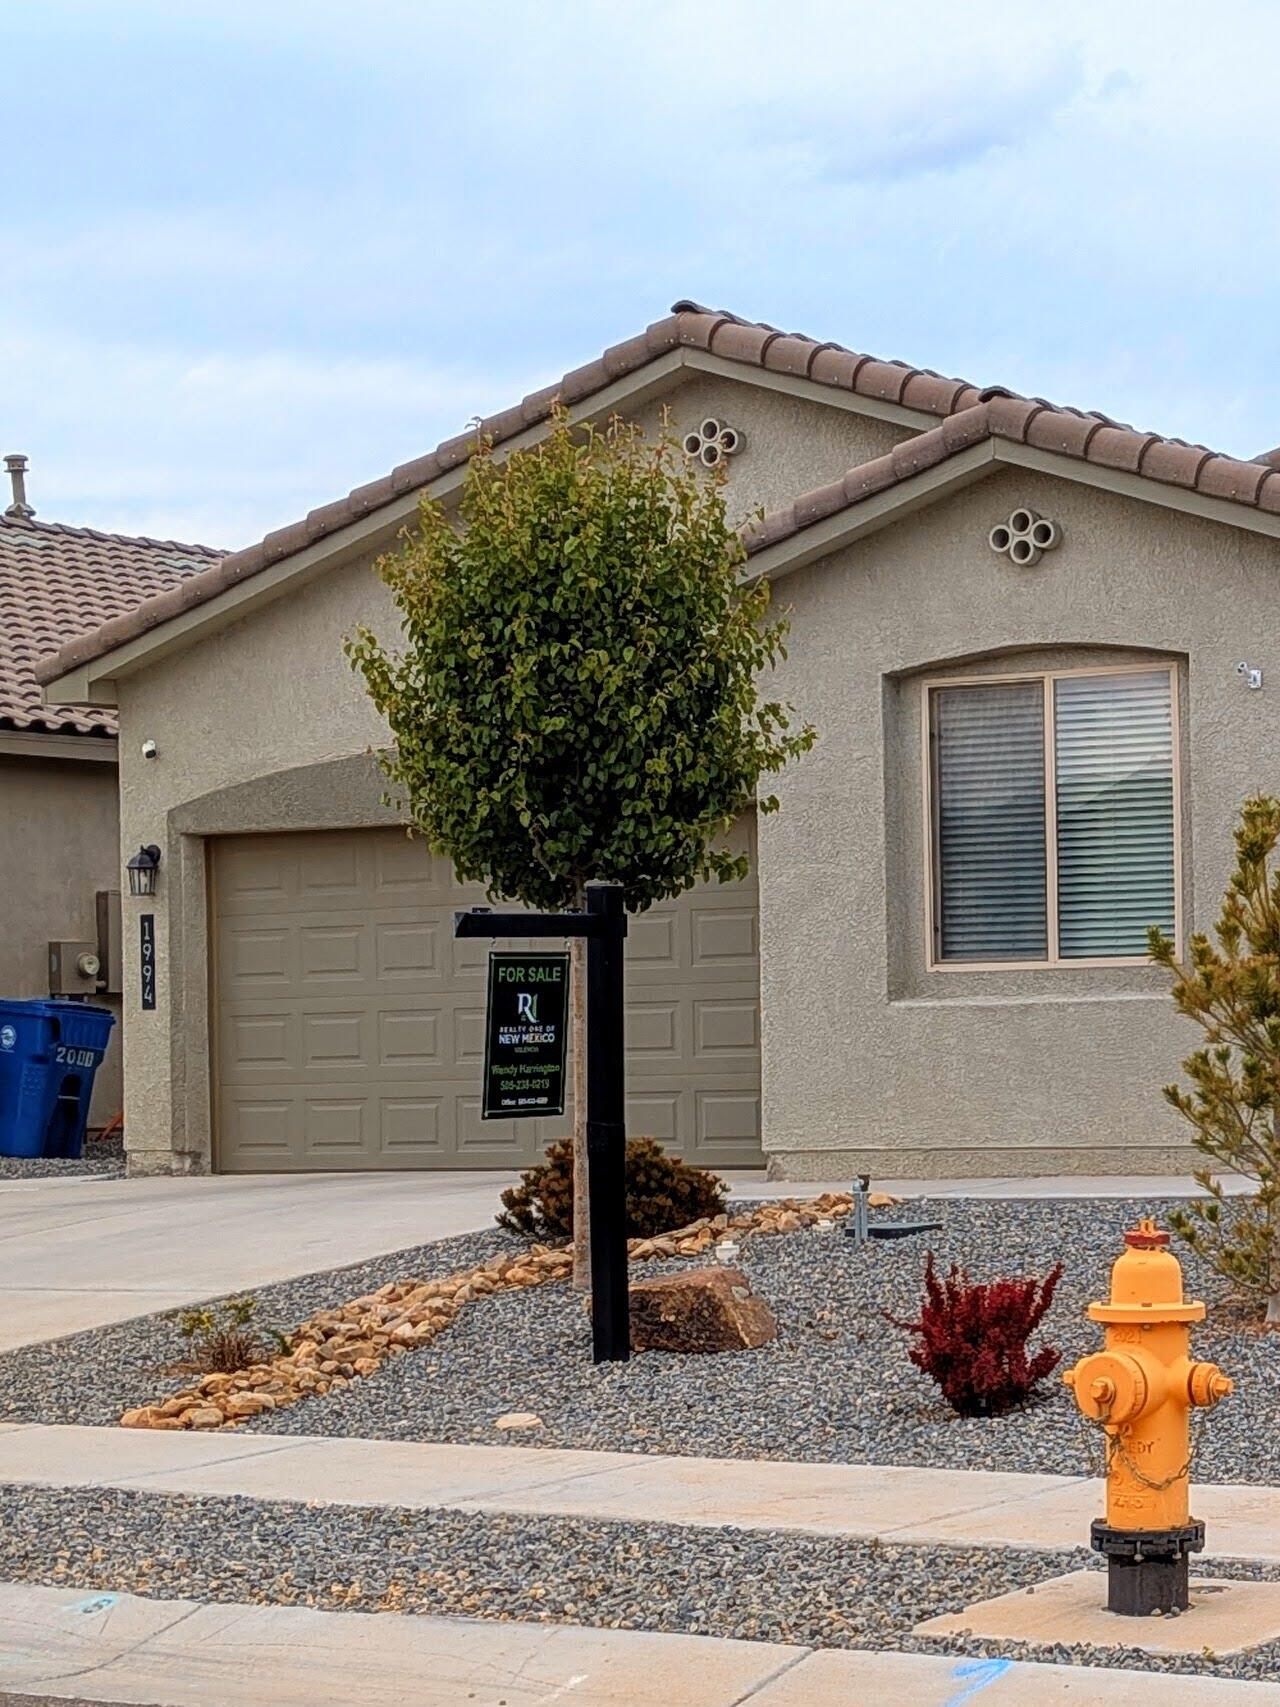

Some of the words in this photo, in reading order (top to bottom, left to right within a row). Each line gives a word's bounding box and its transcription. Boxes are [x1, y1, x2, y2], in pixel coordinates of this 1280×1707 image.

[143, 922, 152, 1003] 1994
[498, 967, 525, 982] FOR
[528, 966, 561, 982] SALE
[498, 1033, 520, 1044] NEW
[521, 1033, 555, 1044] MEXICO
